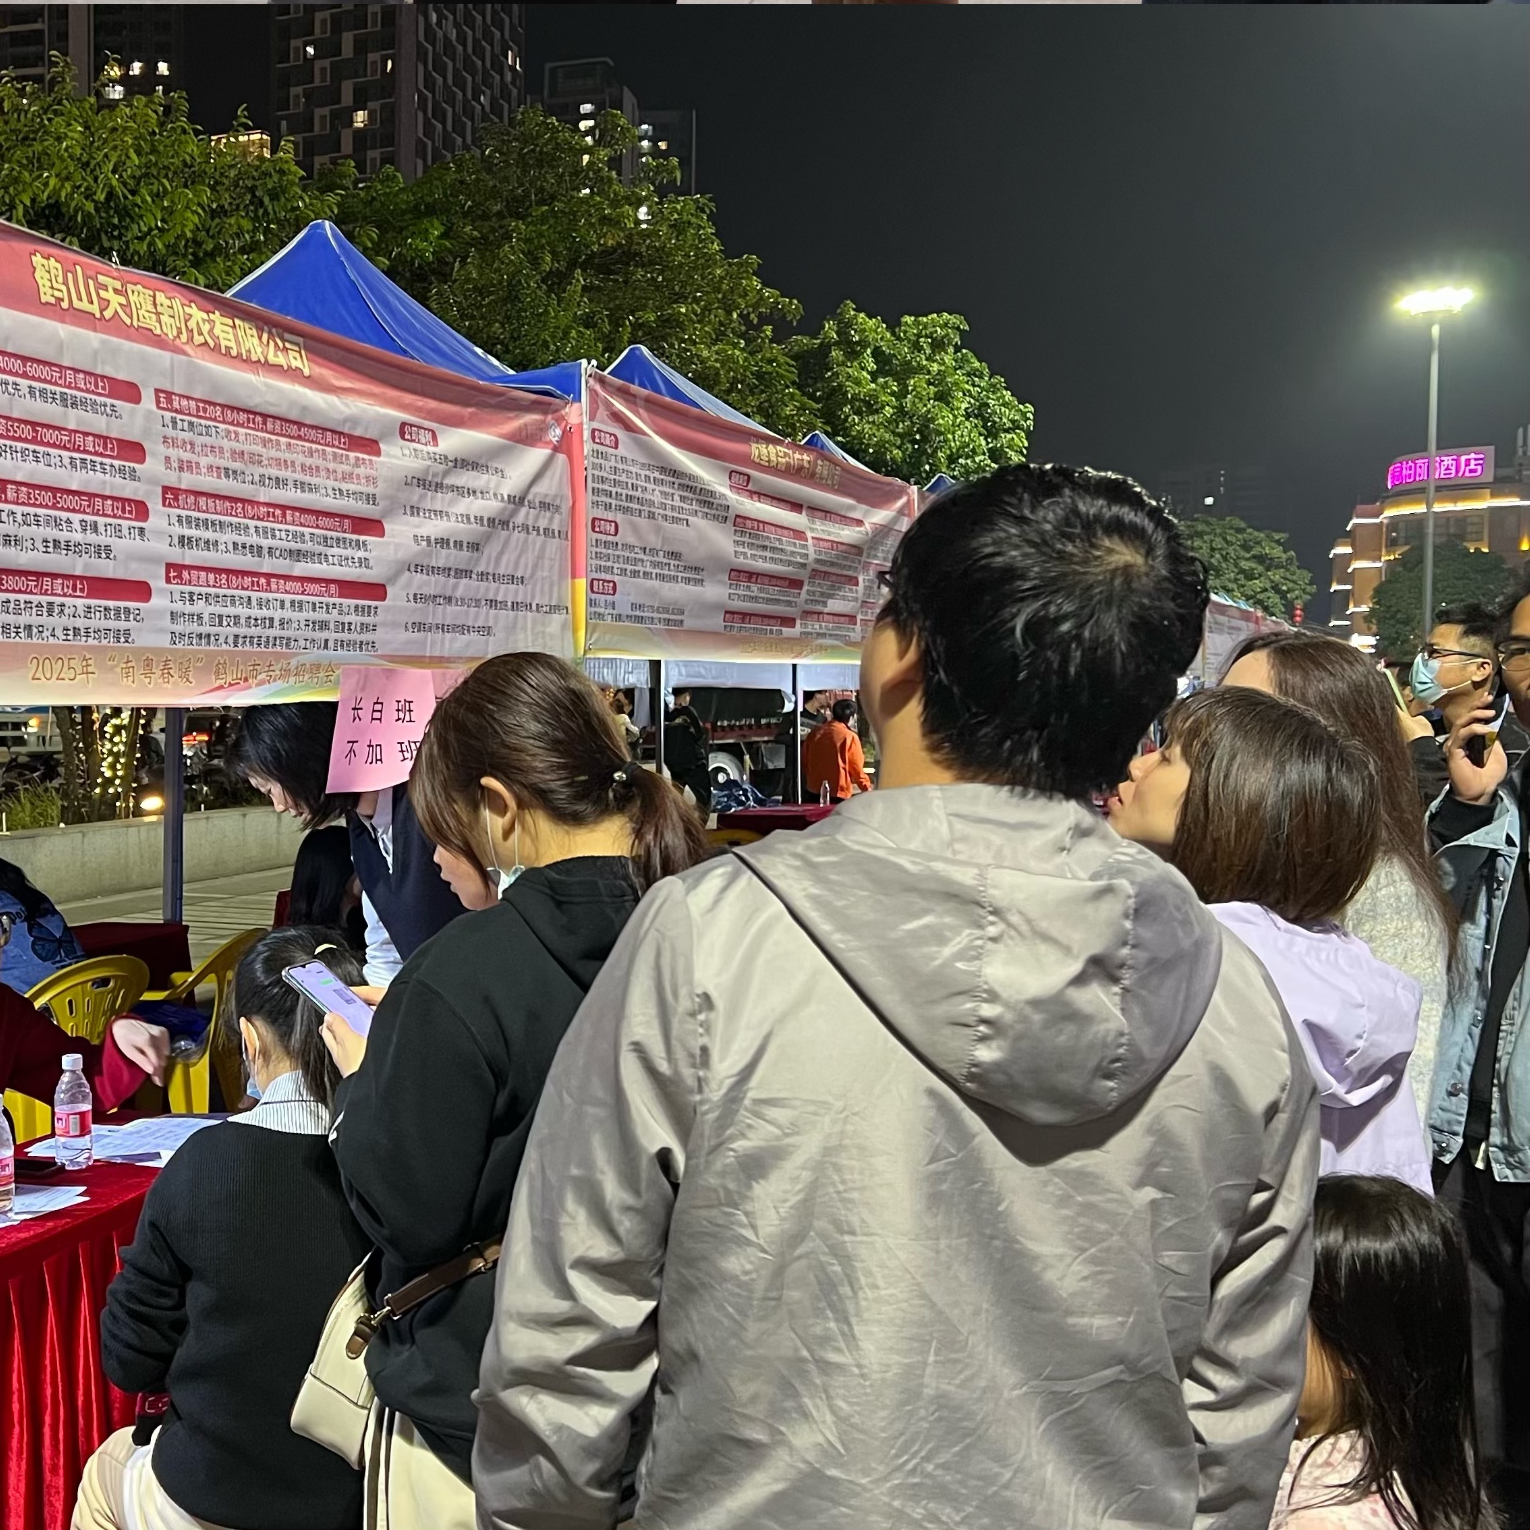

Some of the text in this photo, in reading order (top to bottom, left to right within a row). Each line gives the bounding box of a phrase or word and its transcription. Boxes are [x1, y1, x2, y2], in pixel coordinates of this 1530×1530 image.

[30, 252, 310, 377] 鹤山天鹰制衣有限公司
[351, 695, 416, 724] 长白班
